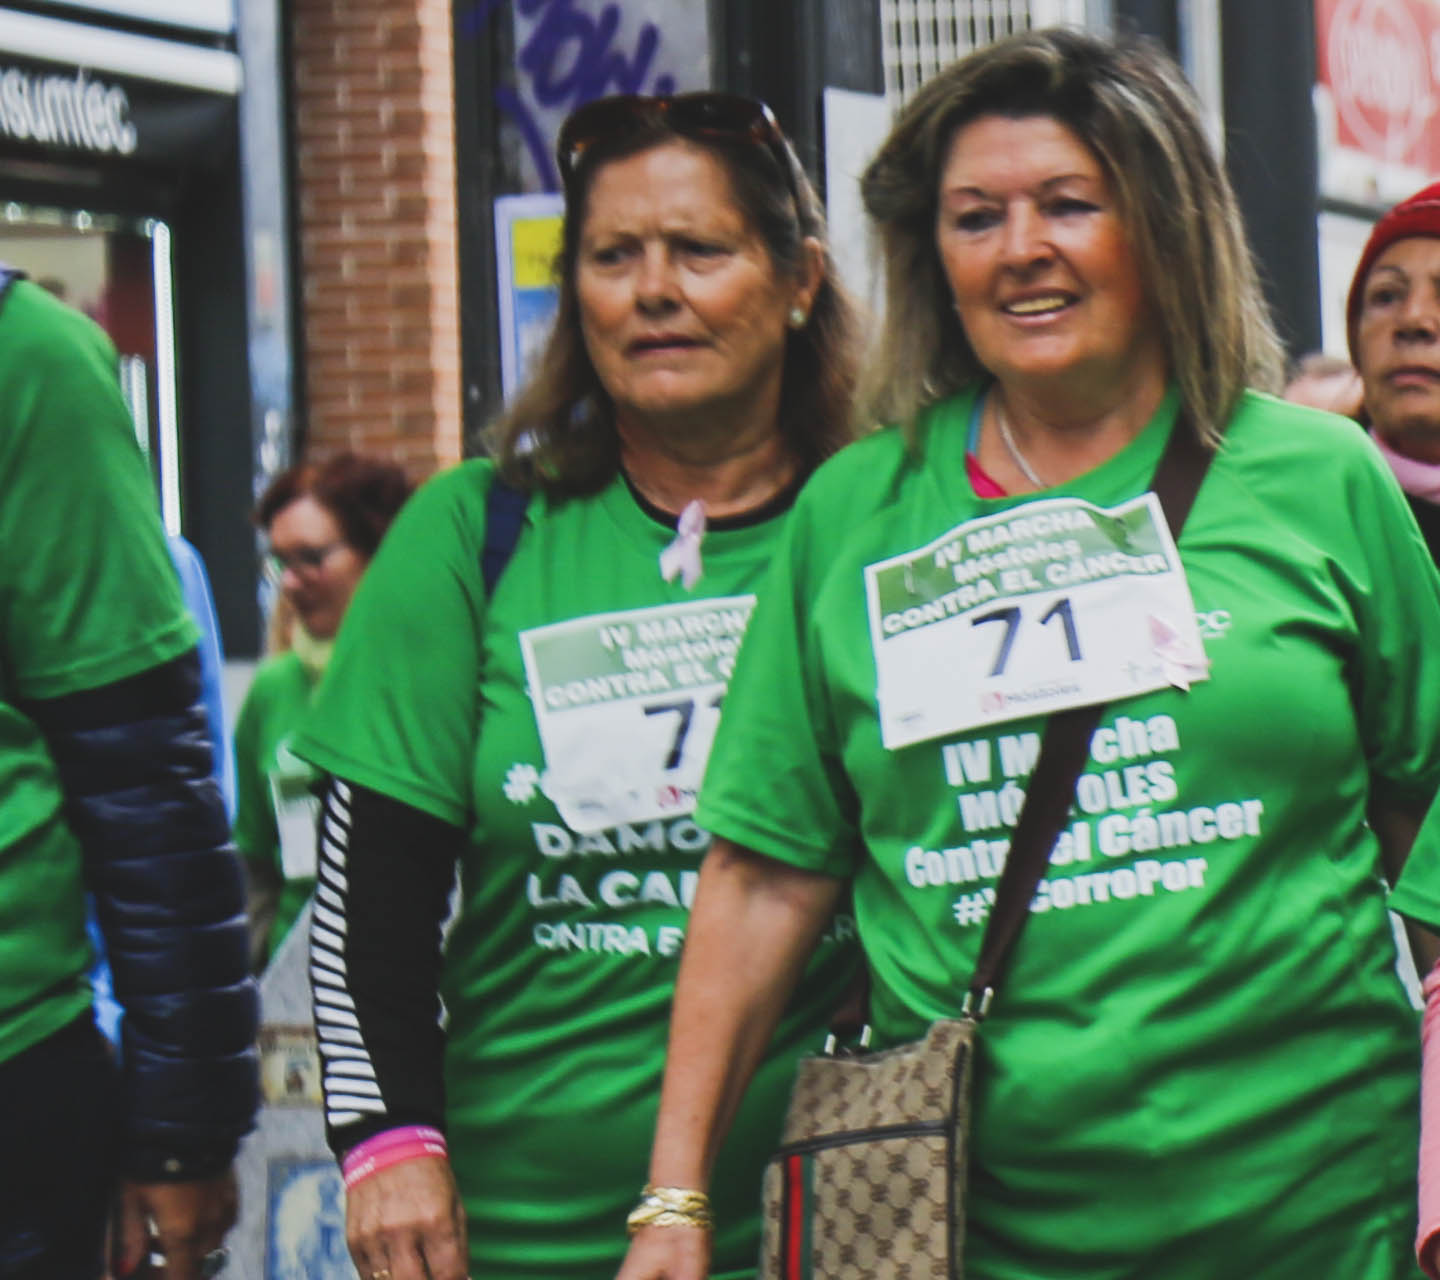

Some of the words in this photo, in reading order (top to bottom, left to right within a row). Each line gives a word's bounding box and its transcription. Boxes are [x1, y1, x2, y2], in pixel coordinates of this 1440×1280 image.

[934, 542, 962, 568] IV
[967, 510, 1095, 553] MARCHA
[954, 539, 1081, 583] Móstoles
[601, 626, 630, 650] IV
[637, 607, 751, 642] MARCH
[883, 579, 997, 634] CONTRA
[1000, 569, 1042, 592] EL
[1046, 552, 1169, 585] CÁNCER
[971, 599, 1082, 677] 71
[546, 670, 670, 707] CONTRA
[674, 662, 714, 684] EL
[643, 694, 721, 770] 7
[942, 739, 991, 786] IV
[999, 715, 1179, 778] Mcha
[959, 761, 1177, 832] MÓOLES
[905, 839, 1011, 887] Contr
[1099, 799, 1263, 858] Cáncer
[527, 873, 597, 910] LA
